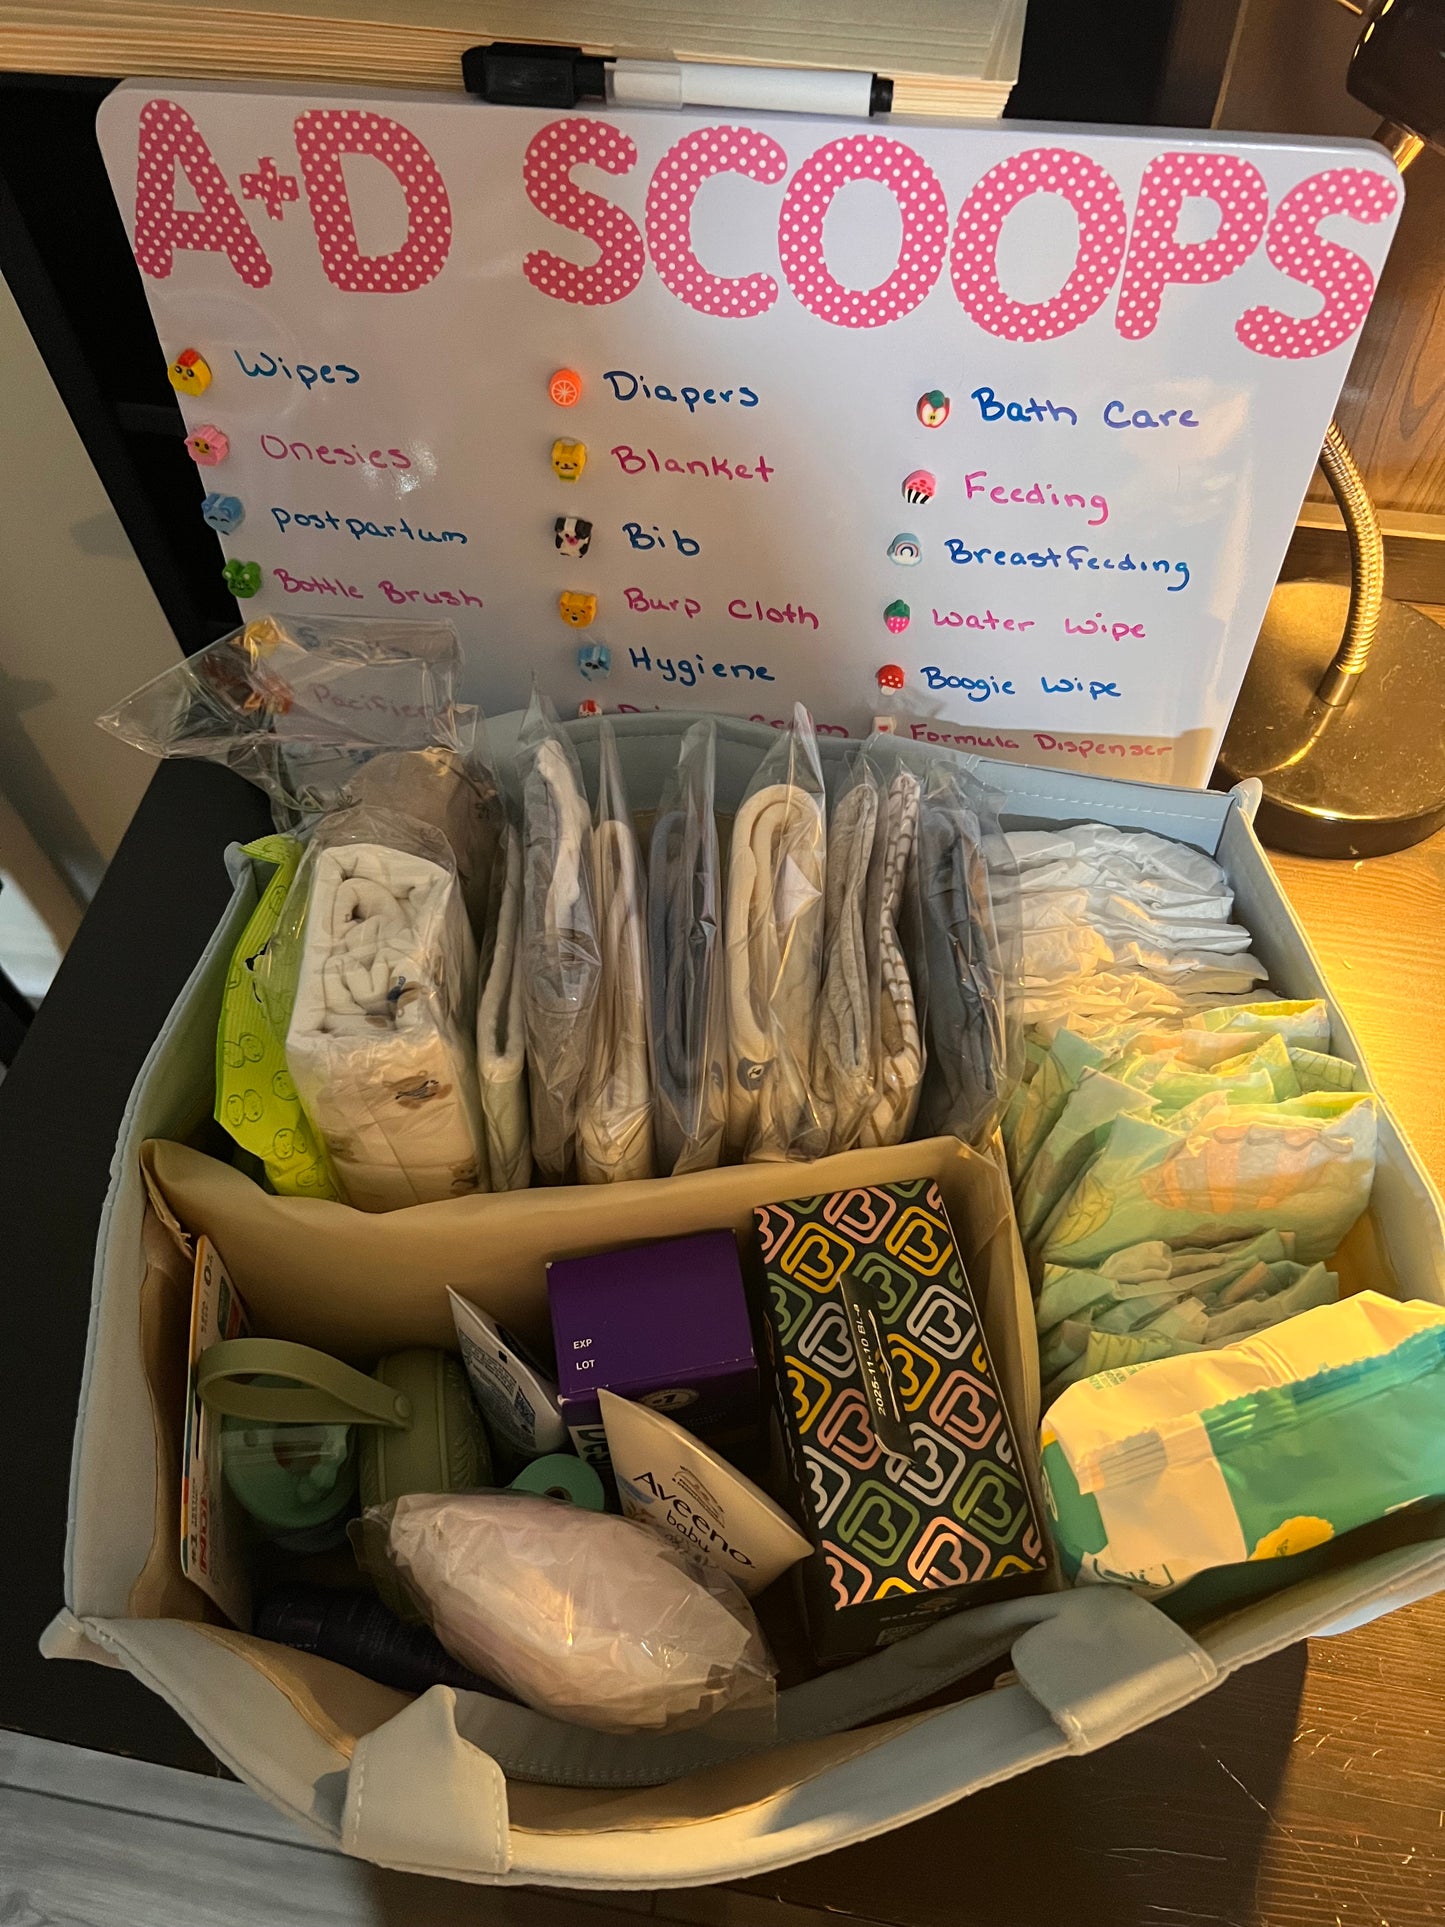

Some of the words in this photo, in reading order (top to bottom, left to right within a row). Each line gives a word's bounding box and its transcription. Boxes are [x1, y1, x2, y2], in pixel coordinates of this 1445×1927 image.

[135, 100, 452, 294] A+D
[523, 118, 1398, 359] SCOOPS
[235, 352, 359, 389] Wipes
[603, 370, 760, 413] Diapers
[971, 387, 1077, 425] Bath
[1103, 400, 1198, 429] Care
[261, 436, 411, 469] Onesies
[610, 445, 774, 483] Blanket
[964, 470, 1109, 527] Feeding
[623, 523, 700, 556] Bib
[944, 538, 1190, 592] Breastfeeding
[273, 568, 361, 598] Bottle
[379, 581, 482, 607] Brush
[624, 587, 701, 618] Burp
[728, 599, 819, 630] Cloth
[629, 647, 775, 686] Hygiene
[921, 666, 1015, 703] Boogie
[910, 724, 1019, 748] Formula
[1033, 733, 1173, 758] Dispenser
[572, 1337, 593, 1351] EXP
[574, 1358, 596, 1372] LOT
[862, 1337, 887, 1418] 2025-11-10
[633, 1471, 755, 1567] Aveeno
[665, 1508, 712, 1554] baby
